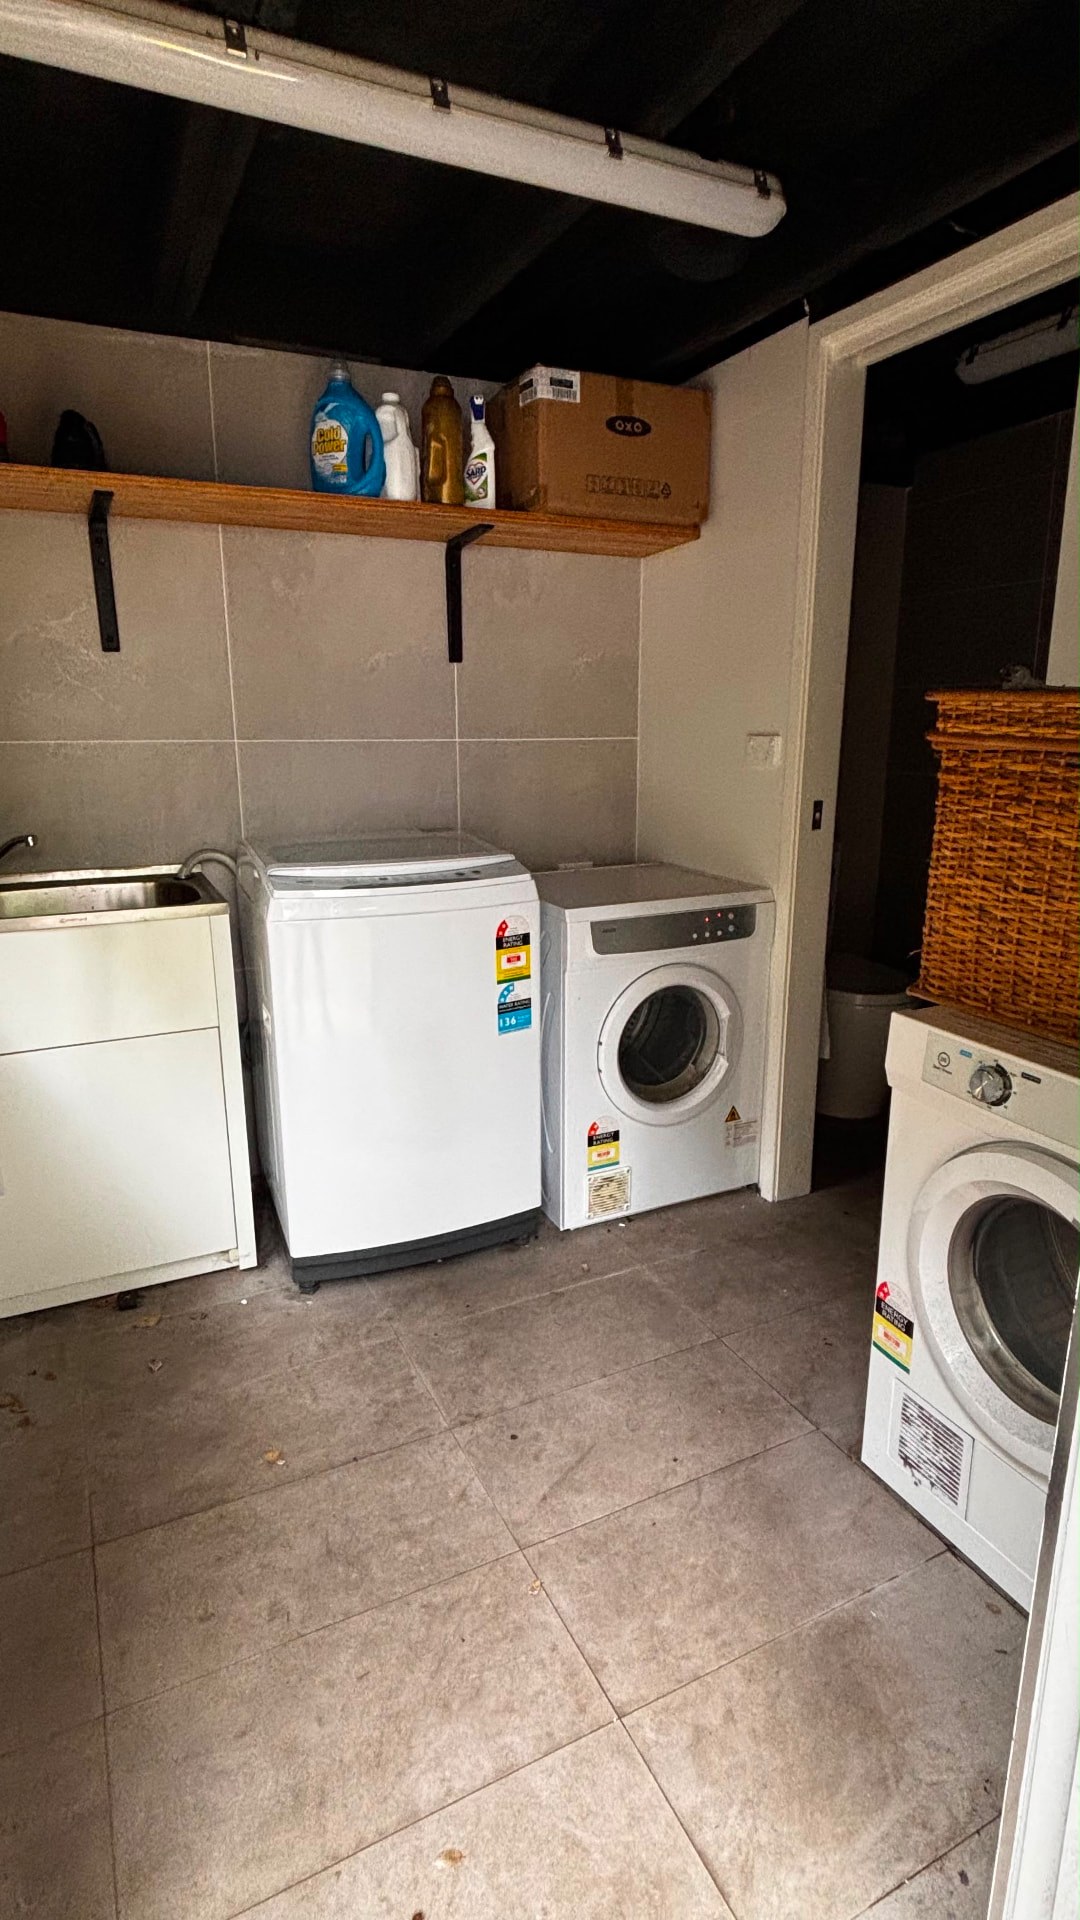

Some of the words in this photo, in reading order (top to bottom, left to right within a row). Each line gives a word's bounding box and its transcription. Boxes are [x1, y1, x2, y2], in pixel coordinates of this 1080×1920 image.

[317, 425, 342, 441] Cold
[615, 420, 642, 433] OXO
[312, 440, 346, 455] Power
[503, 935, 523, 943] ENERGY
[499, 1016, 516, 1027] 136
[593, 1132, 614, 1140] ENERGY
[593, 1138, 613, 1146] RATING
[881, 1302, 908, 1326] ENERGY
[881, 1310, 906, 1332] RATING
